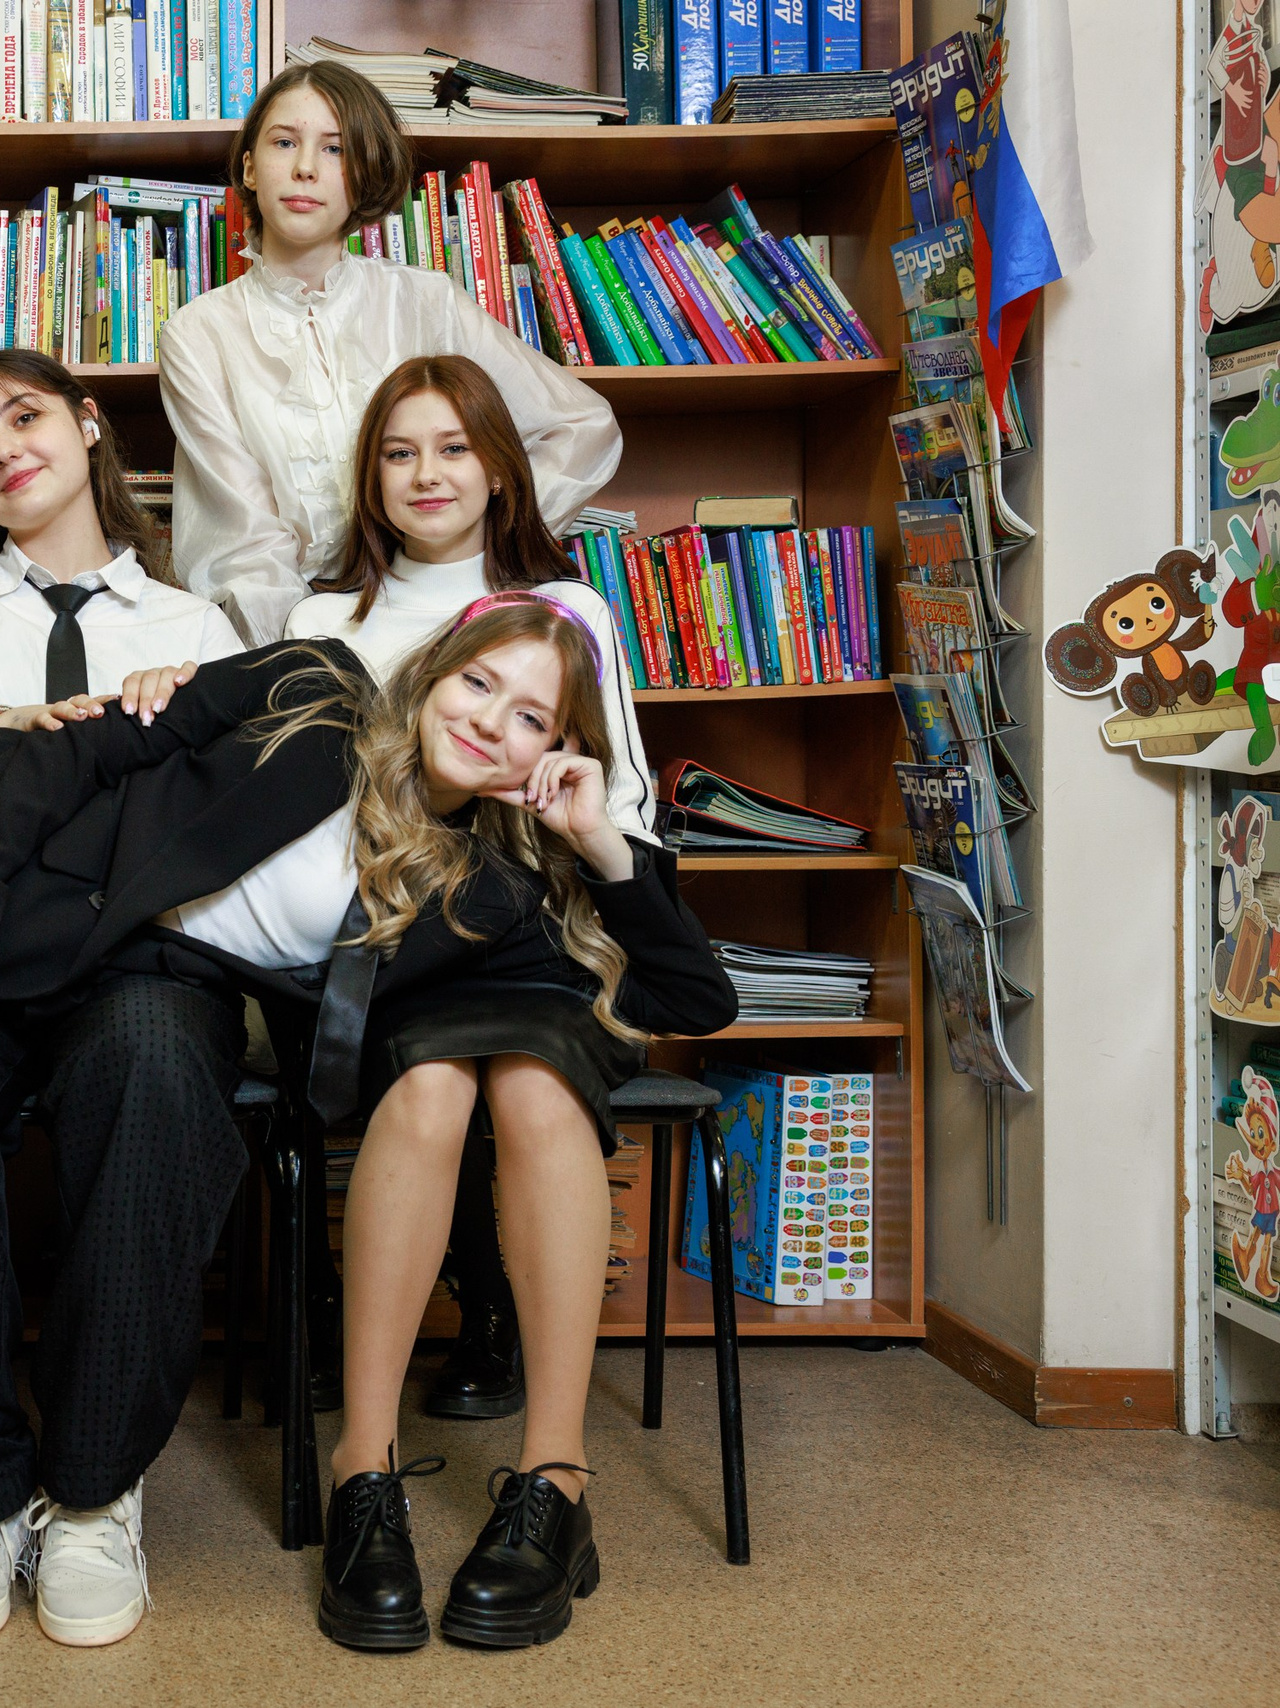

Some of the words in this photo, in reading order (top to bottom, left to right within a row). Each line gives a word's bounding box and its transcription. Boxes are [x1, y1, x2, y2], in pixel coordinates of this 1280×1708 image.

[4, 35, 16, 63] ГОДА
[113, 22, 125, 52] МИР
[4, 65, 16, 114] ВРЕМЕНА
[114, 56, 126, 107] СОФИИ
[49, 194, 57, 240] ВЕЛОСИПЕДЕ
[47, 254, 55, 287] ШКАФОМ
